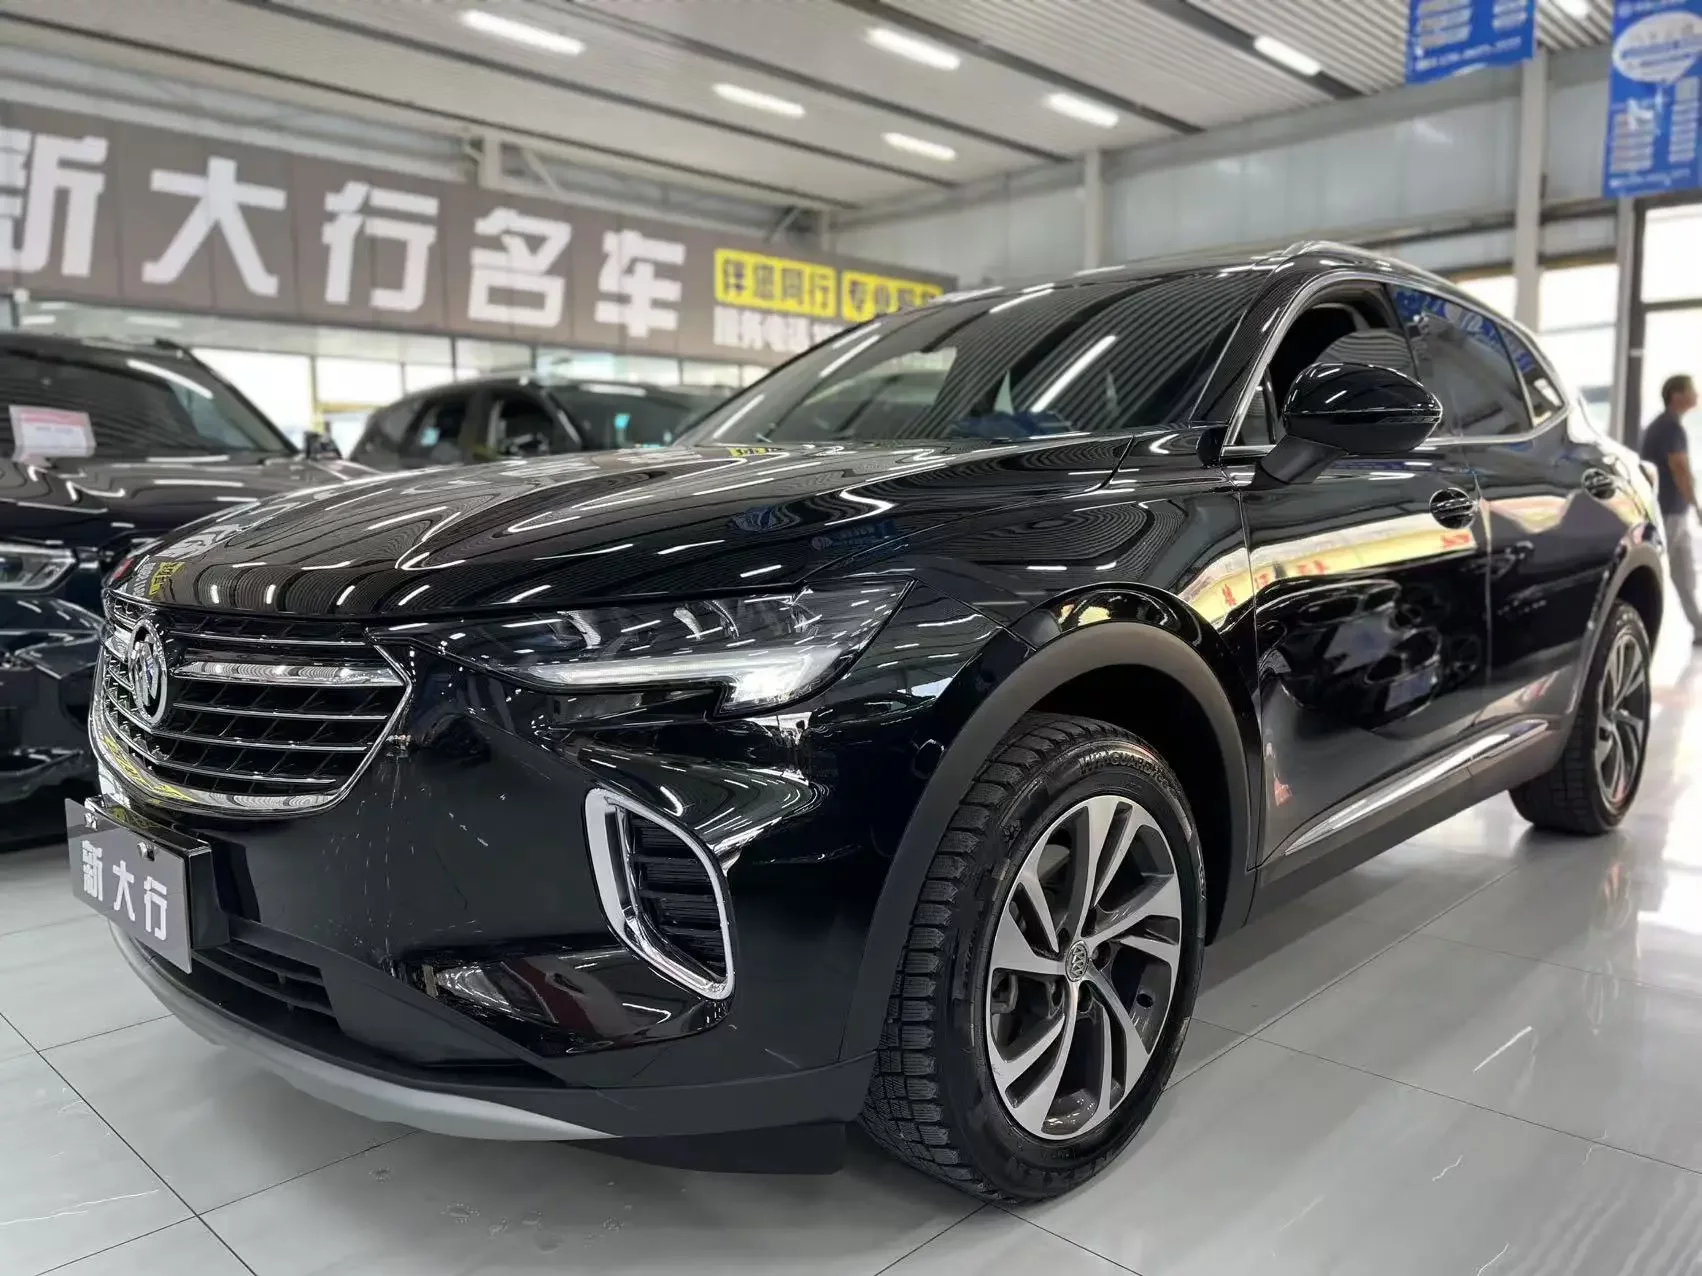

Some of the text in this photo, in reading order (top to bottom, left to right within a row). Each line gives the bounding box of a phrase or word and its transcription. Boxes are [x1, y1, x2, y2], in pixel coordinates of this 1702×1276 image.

[0, 128, 685, 337] 新大行名车
[81, 839, 168, 941] 新大行
